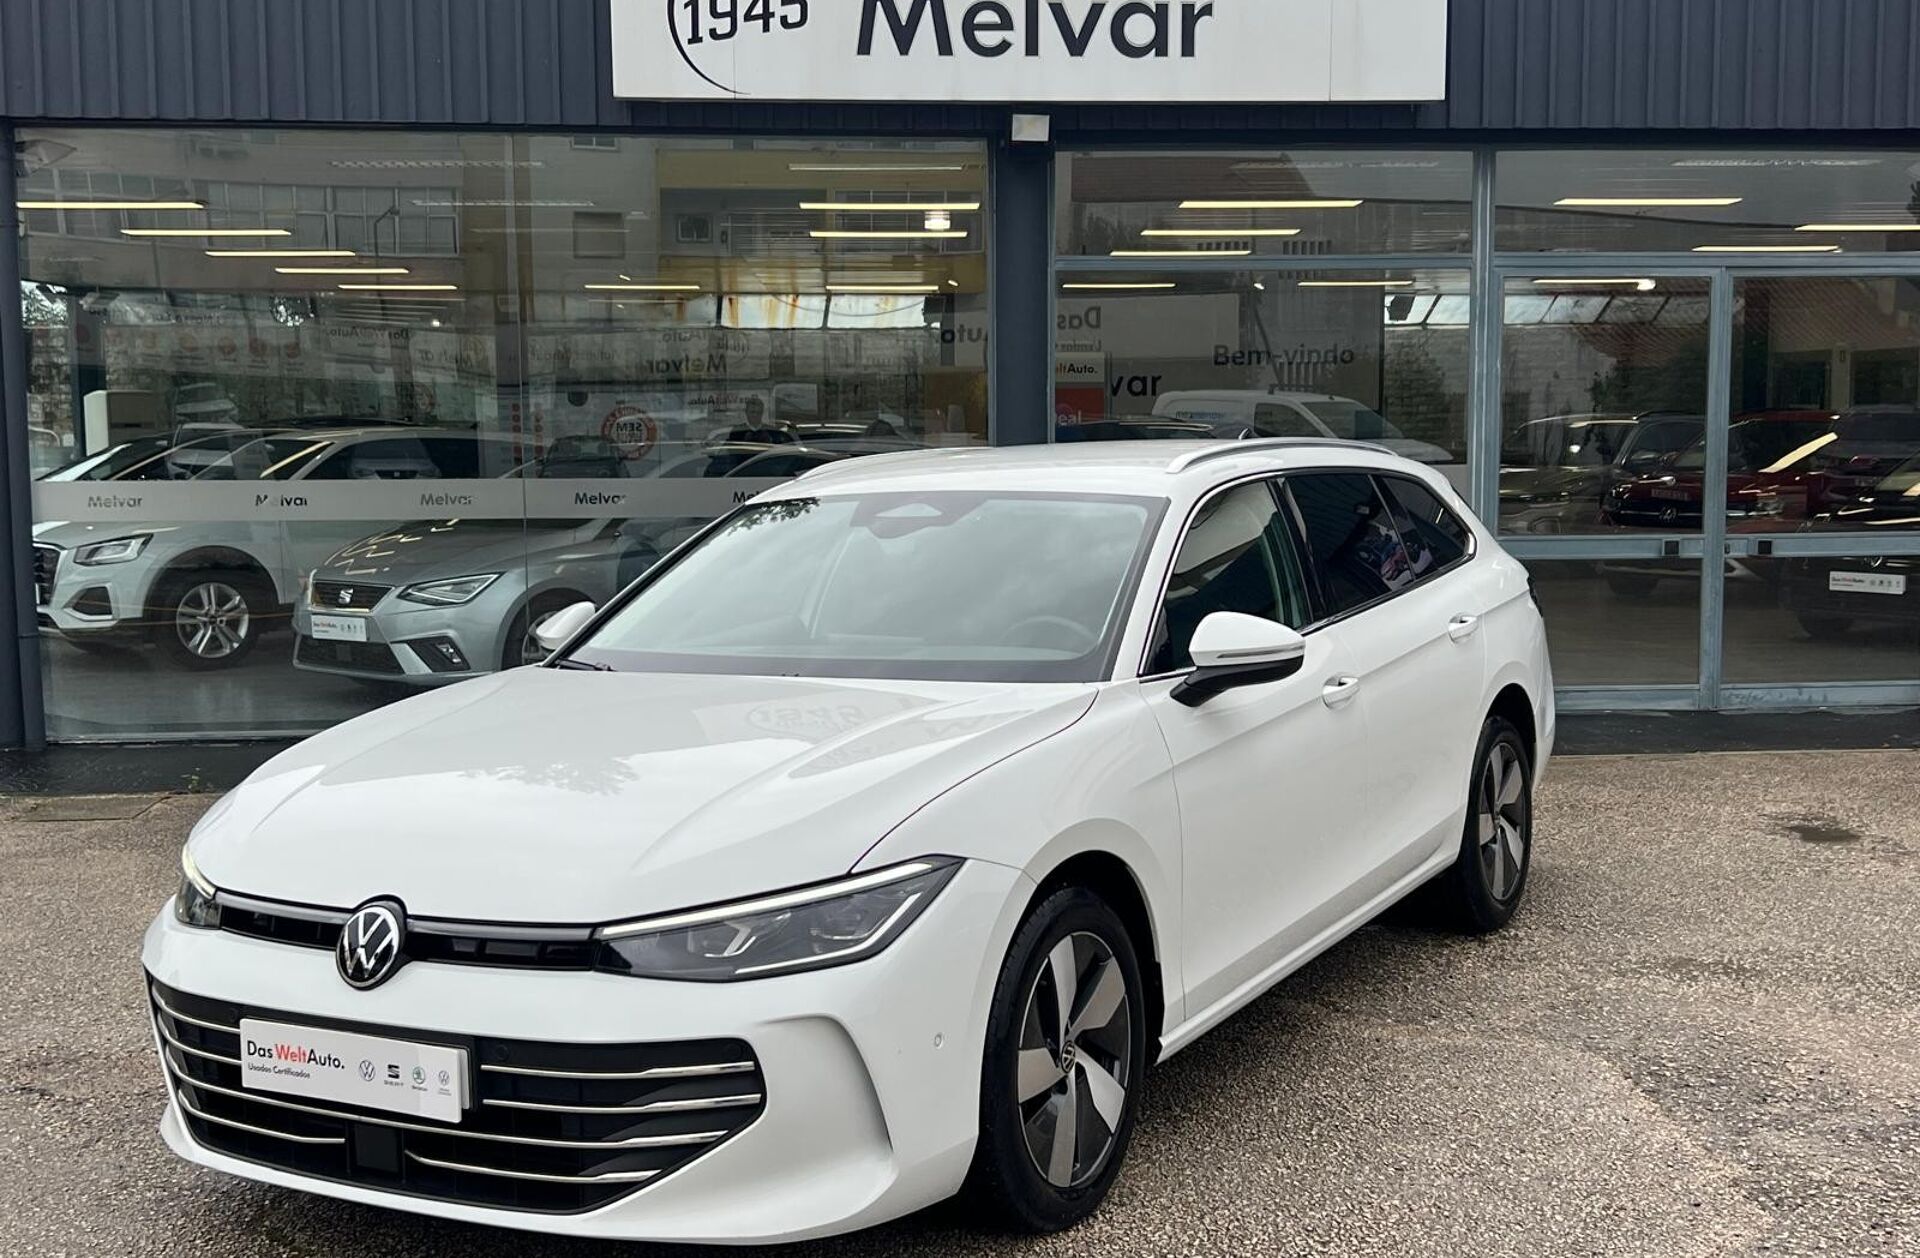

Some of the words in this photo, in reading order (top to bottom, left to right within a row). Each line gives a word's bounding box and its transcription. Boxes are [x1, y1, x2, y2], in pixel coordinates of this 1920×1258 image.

[684, 0, 808, 45] 1945
[857, 0, 1213, 58] Melvar
[1213, 343, 1354, 366] Bem-vindo
[88, 495, 143, 507] Melvar
[246, 1040, 274, 1059] Das
[275, 1043, 345, 1069] WeltAuto.
